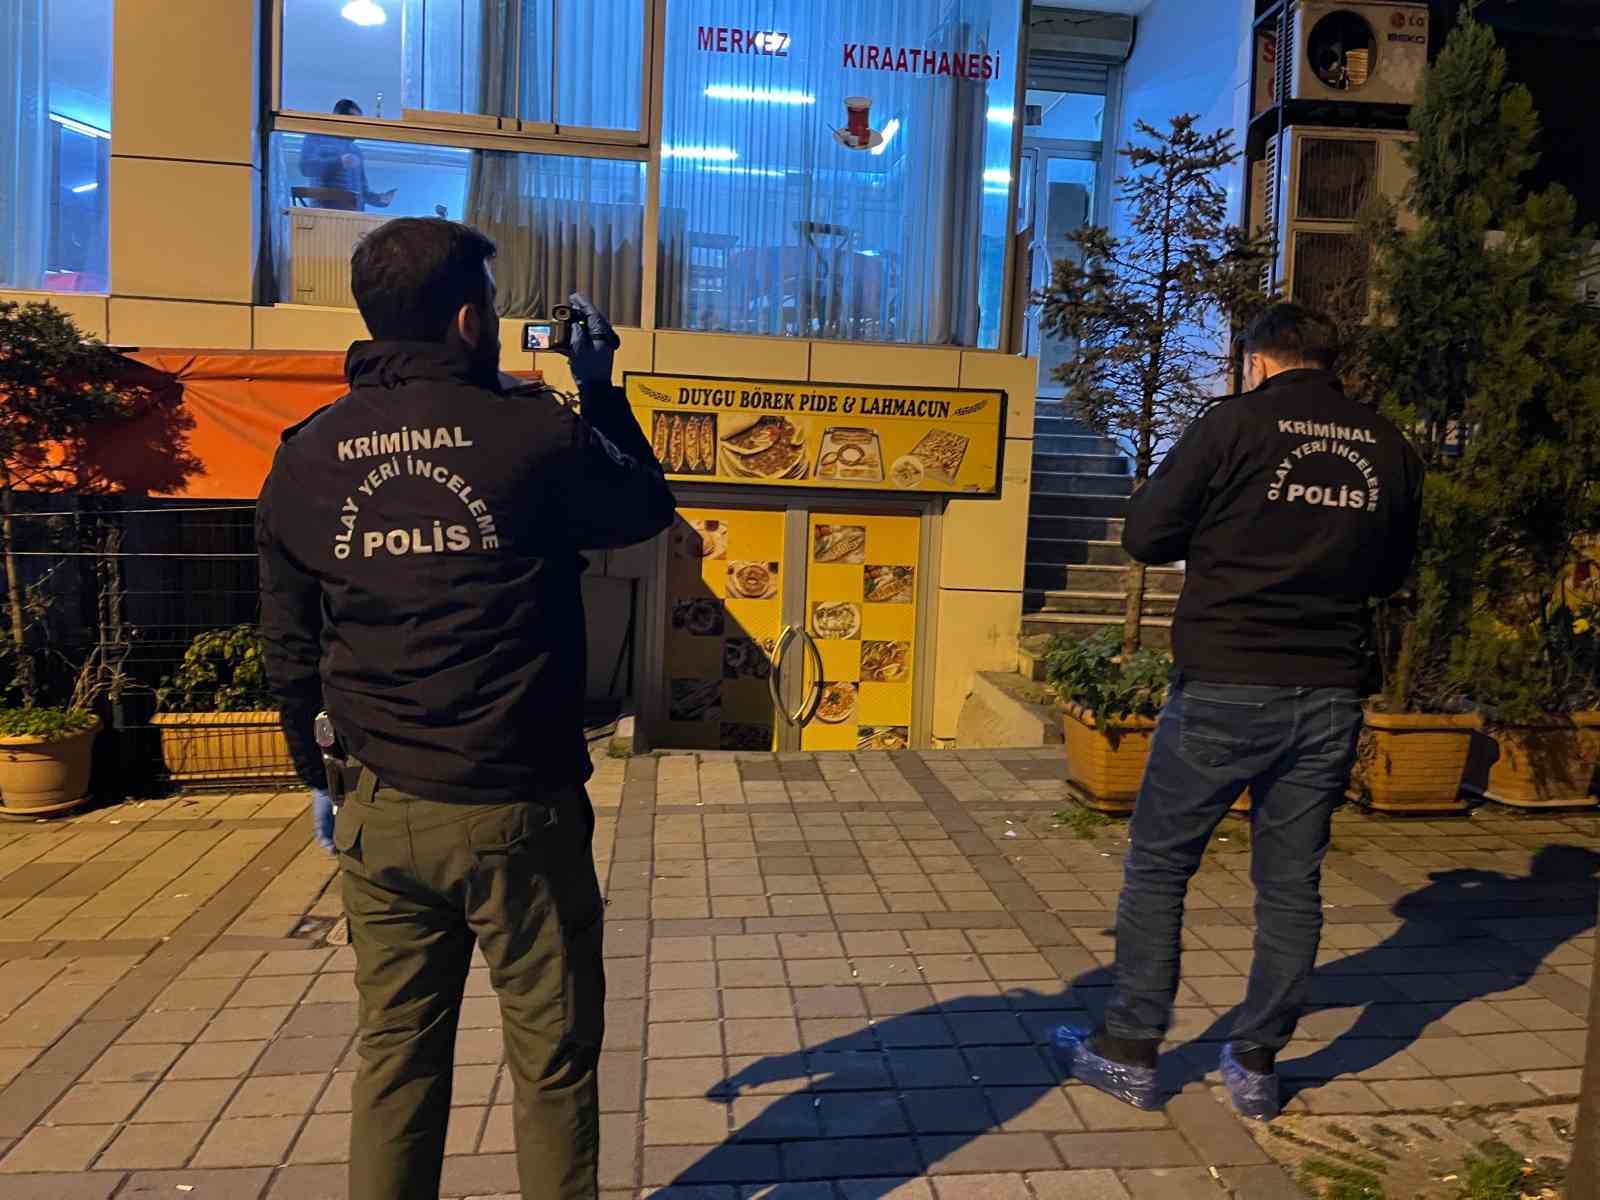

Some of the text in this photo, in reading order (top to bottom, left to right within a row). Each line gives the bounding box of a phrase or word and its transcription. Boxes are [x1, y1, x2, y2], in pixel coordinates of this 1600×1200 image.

[697, 26, 1000, 80] MERKEZ KIRAATHANESİ
[677, 387, 952, 419] DUYGU BÖREK PİDE & LAHMACUN
[337, 426, 472, 461] KRİMİNAL
[1278, 420, 1377, 443] KRİMİNAL
[1266, 457, 1293, 501] OLAY
[1291, 439, 1328, 459] YERİ
[334, 455, 499, 559] OLAY YERİ İNCELEME
[1287, 484, 1365, 509] POLİS
[363, 520, 471, 558] POLİS
